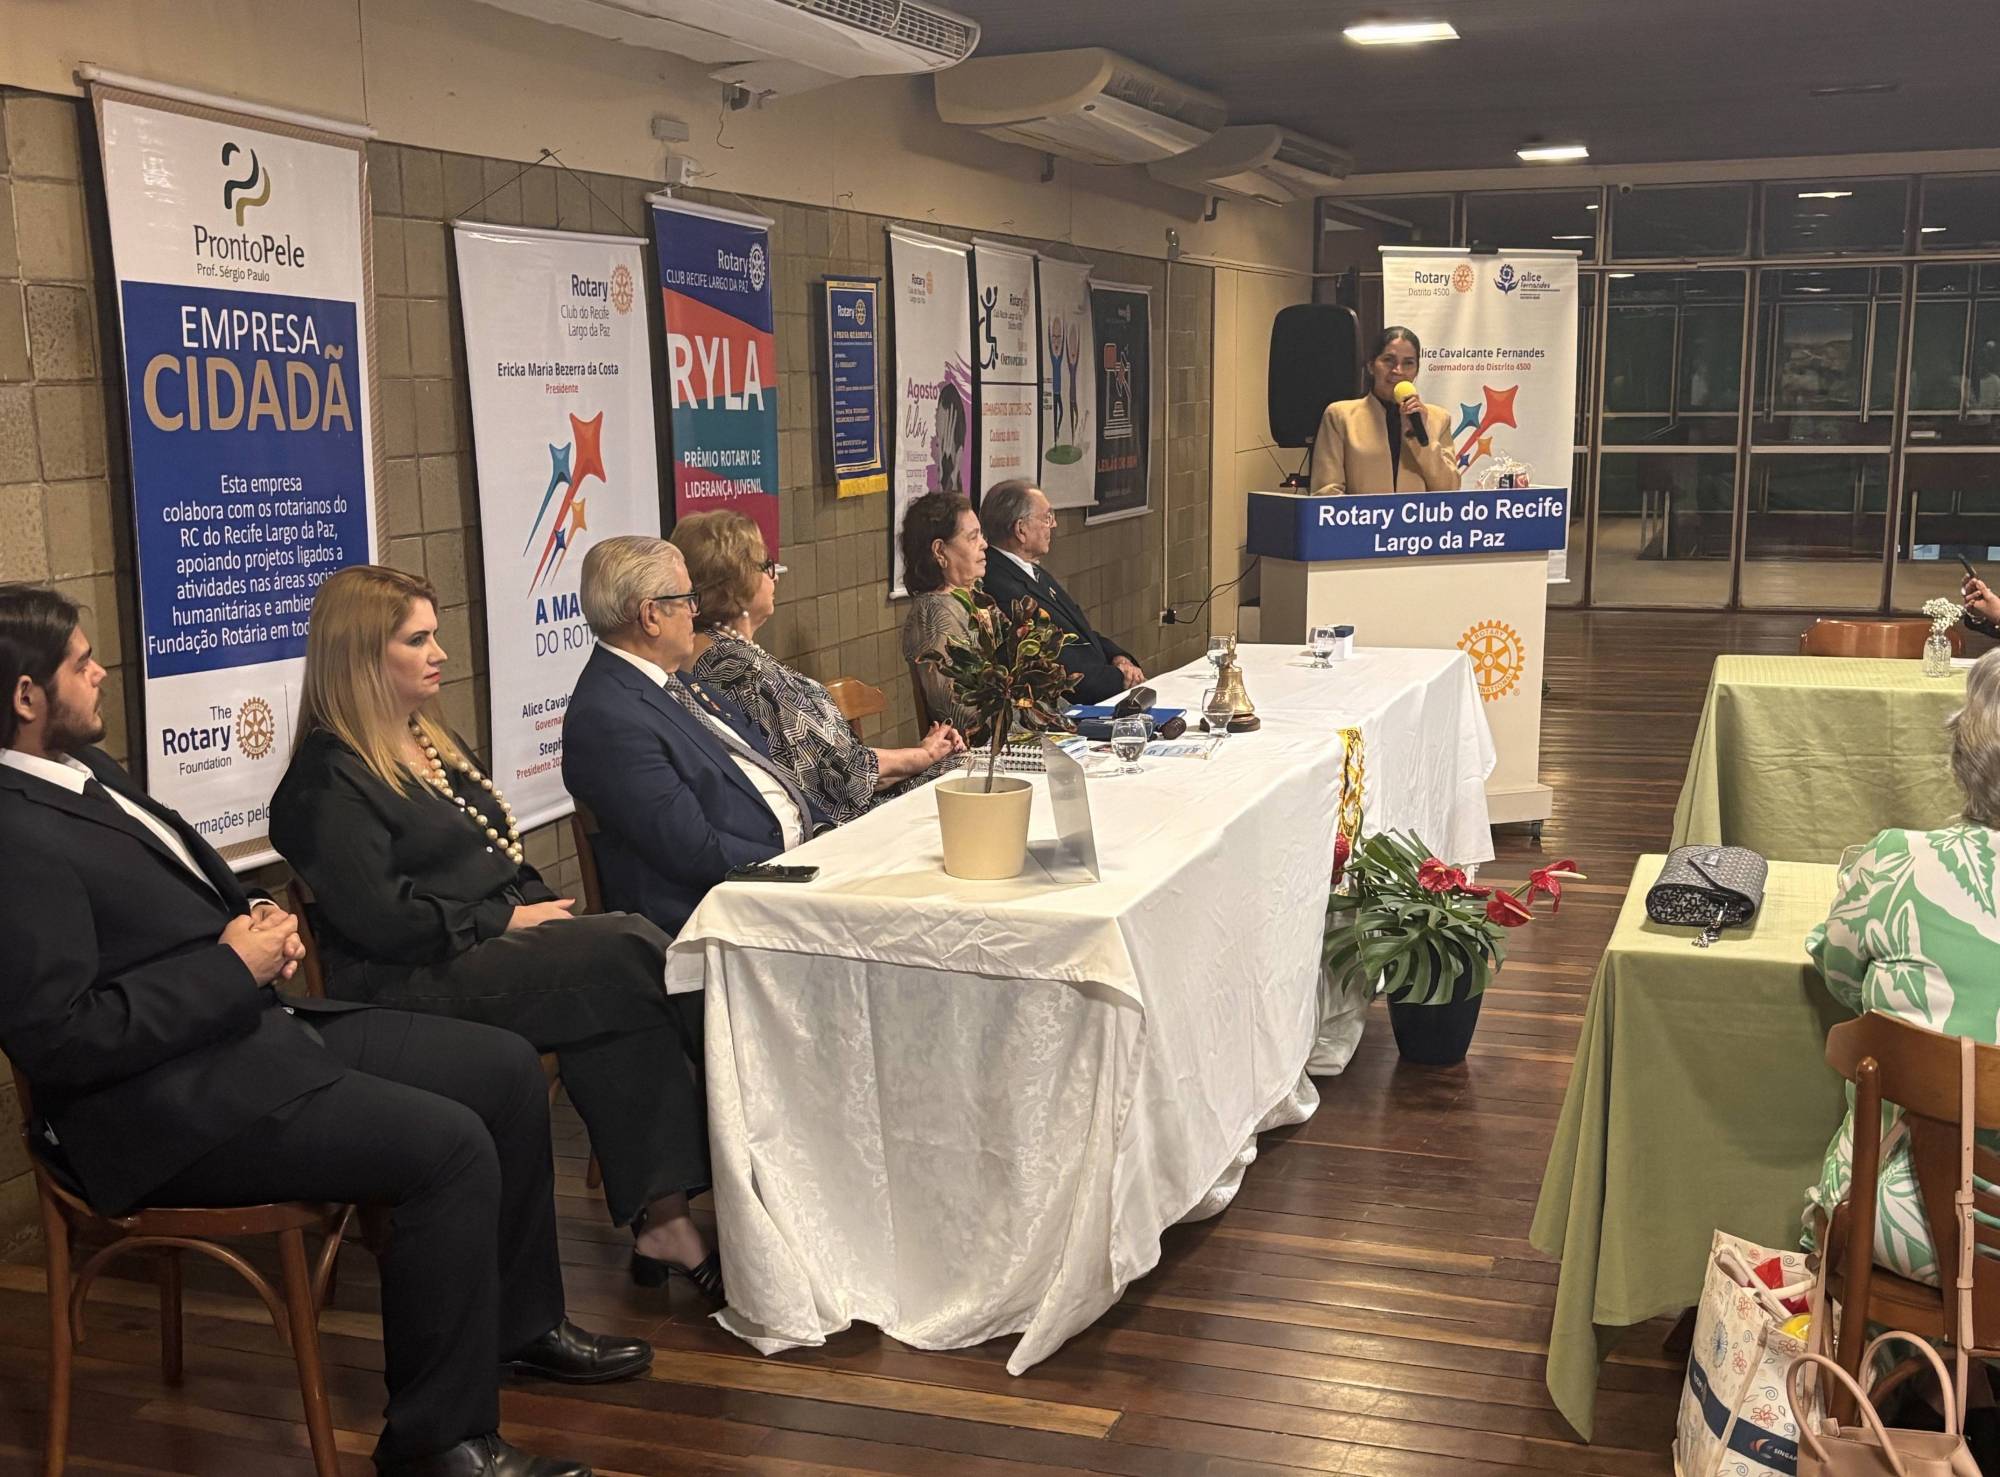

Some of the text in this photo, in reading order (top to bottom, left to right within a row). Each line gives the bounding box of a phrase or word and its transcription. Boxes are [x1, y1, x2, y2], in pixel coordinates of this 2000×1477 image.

[193, 224, 305, 268] ProntoPele
[197, 263, 270, 282] Prof. Sérgio Paulo
[717, 249, 749, 278] Rotary
[666, 269, 749, 293] CLUB RECIFE LARGO DA PAZ
[911, 273, 926, 288] Rotary
[1414, 271, 1450, 286] Rotary
[1520, 271, 1542, 282] alice
[571, 274, 608, 302] Rotary
[1408, 287, 1450, 296] Distrito 4500
[560, 304, 609, 319] Club do Recife
[837, 304, 855, 320] Rotary
[181, 305, 320, 355] EMPRESA
[568, 323, 611, 340] Largo da Paz
[1420, 348, 1545, 358] lice Cavalcante Fernandes
[497, 361, 619, 377] Ericka Maria Bezerra da Costa
[667, 333, 765, 412] RYLA
[1428, 362, 1532, 372] Governadora do Distrito 4500
[143, 344, 354, 432] CIDADÃ
[545, 383, 579, 394] Presidente
[907, 377, 938, 404] Agosto
[684, 446, 762, 468] PRÊMIO ROTARY DE
[221, 474, 302, 496] Esta empresa
[685, 478, 763, 501] LIDERANÇA JUVENIL
[163, 495, 347, 522] colabora com os rotarianos do
[1319, 497, 1563, 529] Rotary Club do Recife
[180, 520, 338, 548] RC do Recife Largo da Paz,
[1374, 529, 1505, 555] Largo da Paz
[176, 545, 343, 577] apoiando projetos ligados a
[176, 567, 337, 600] atividades nas áreas soci
[172, 600, 261, 626] humanitárias
[264, 601, 272, 616] e
[535, 592, 581, 626] A MA
[148, 628, 218, 655] Fundação
[221, 620, 267, 647] Rotária
[270, 620, 289, 637] em
[536, 629, 559, 657] DO
[1474, 629, 1505, 639] ROTARY
[209, 705, 232, 720] The
[522, 701, 543, 718] Alice
[535, 714, 564, 731] Governa
[161, 724, 231, 756] Rotary
[179, 756, 232, 775] Foundation
[516, 763, 551, 779] Presidente
